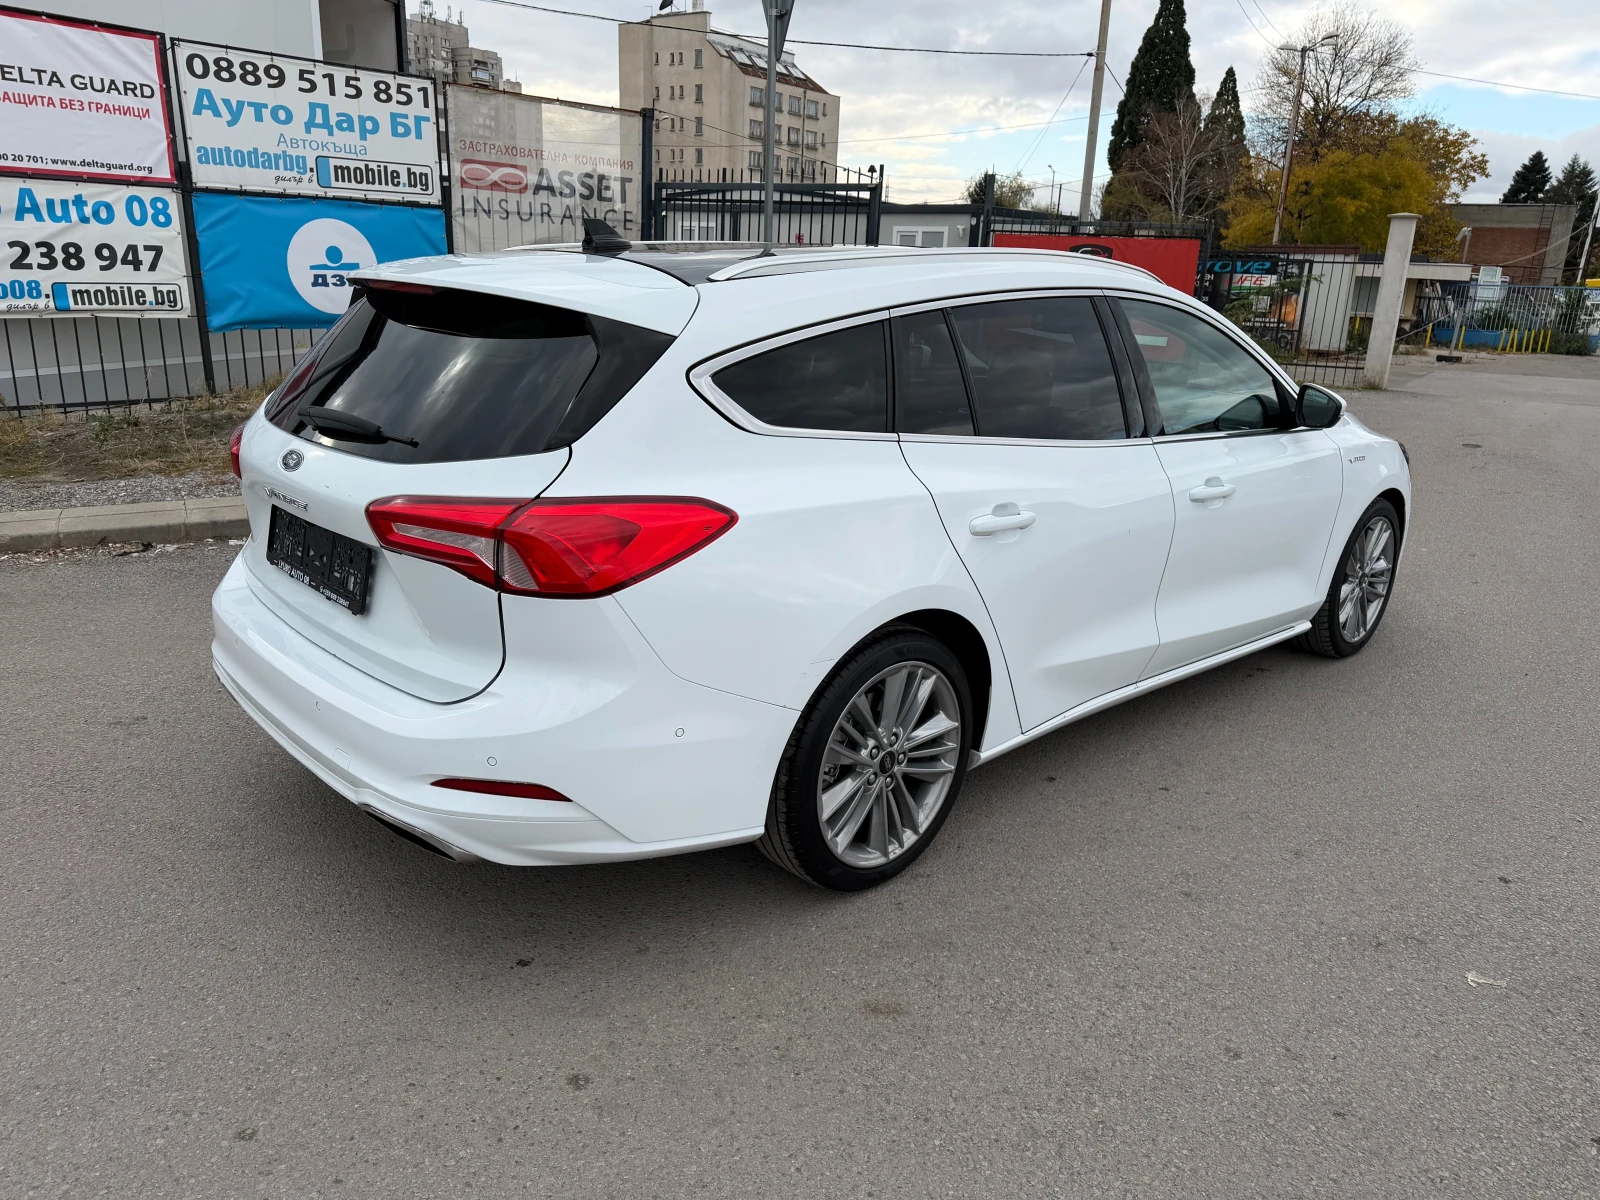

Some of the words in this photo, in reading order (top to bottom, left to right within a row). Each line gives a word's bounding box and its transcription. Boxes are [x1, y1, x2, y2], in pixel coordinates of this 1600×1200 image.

[70, 74, 155, 99] GUARD
[186, 53, 286, 89] 0889
[298, 68, 363, 100] 515
[373, 80, 430, 109] 851
[0, 91, 57, 108] АЩИТА
[59, 98, 85, 112] БЕЗ
[88, 101, 151, 120] ГРАНИЦИ
[192, 88, 294, 128] Ауто
[304, 102, 380, 141] Дар
[389, 112, 431, 140] БГ
[277, 133, 368, 157] Автокъща
[459, 139, 569, 164] ЗАСТРАХОВАТЕЛНА
[574, 154, 634, 171] КОМПАНИЯ
[11, 153, 24, 163] 20
[26, 155, 49, 166] 701;
[50, 157, 154, 174] www.deltaguard.org
[333, 163, 430, 192] mobile.bg
[532, 167, 633, 204] ASSET
[14, 187, 116, 225] Auto
[125, 194, 173, 228] 08
[7, 240, 86, 271] 238
[94, 243, 164, 272] 947
[311, 273, 354, 288] ДЗ
[71, 285, 178, 309] mobile.bg
[290, 567, 304, 582] AUTO
